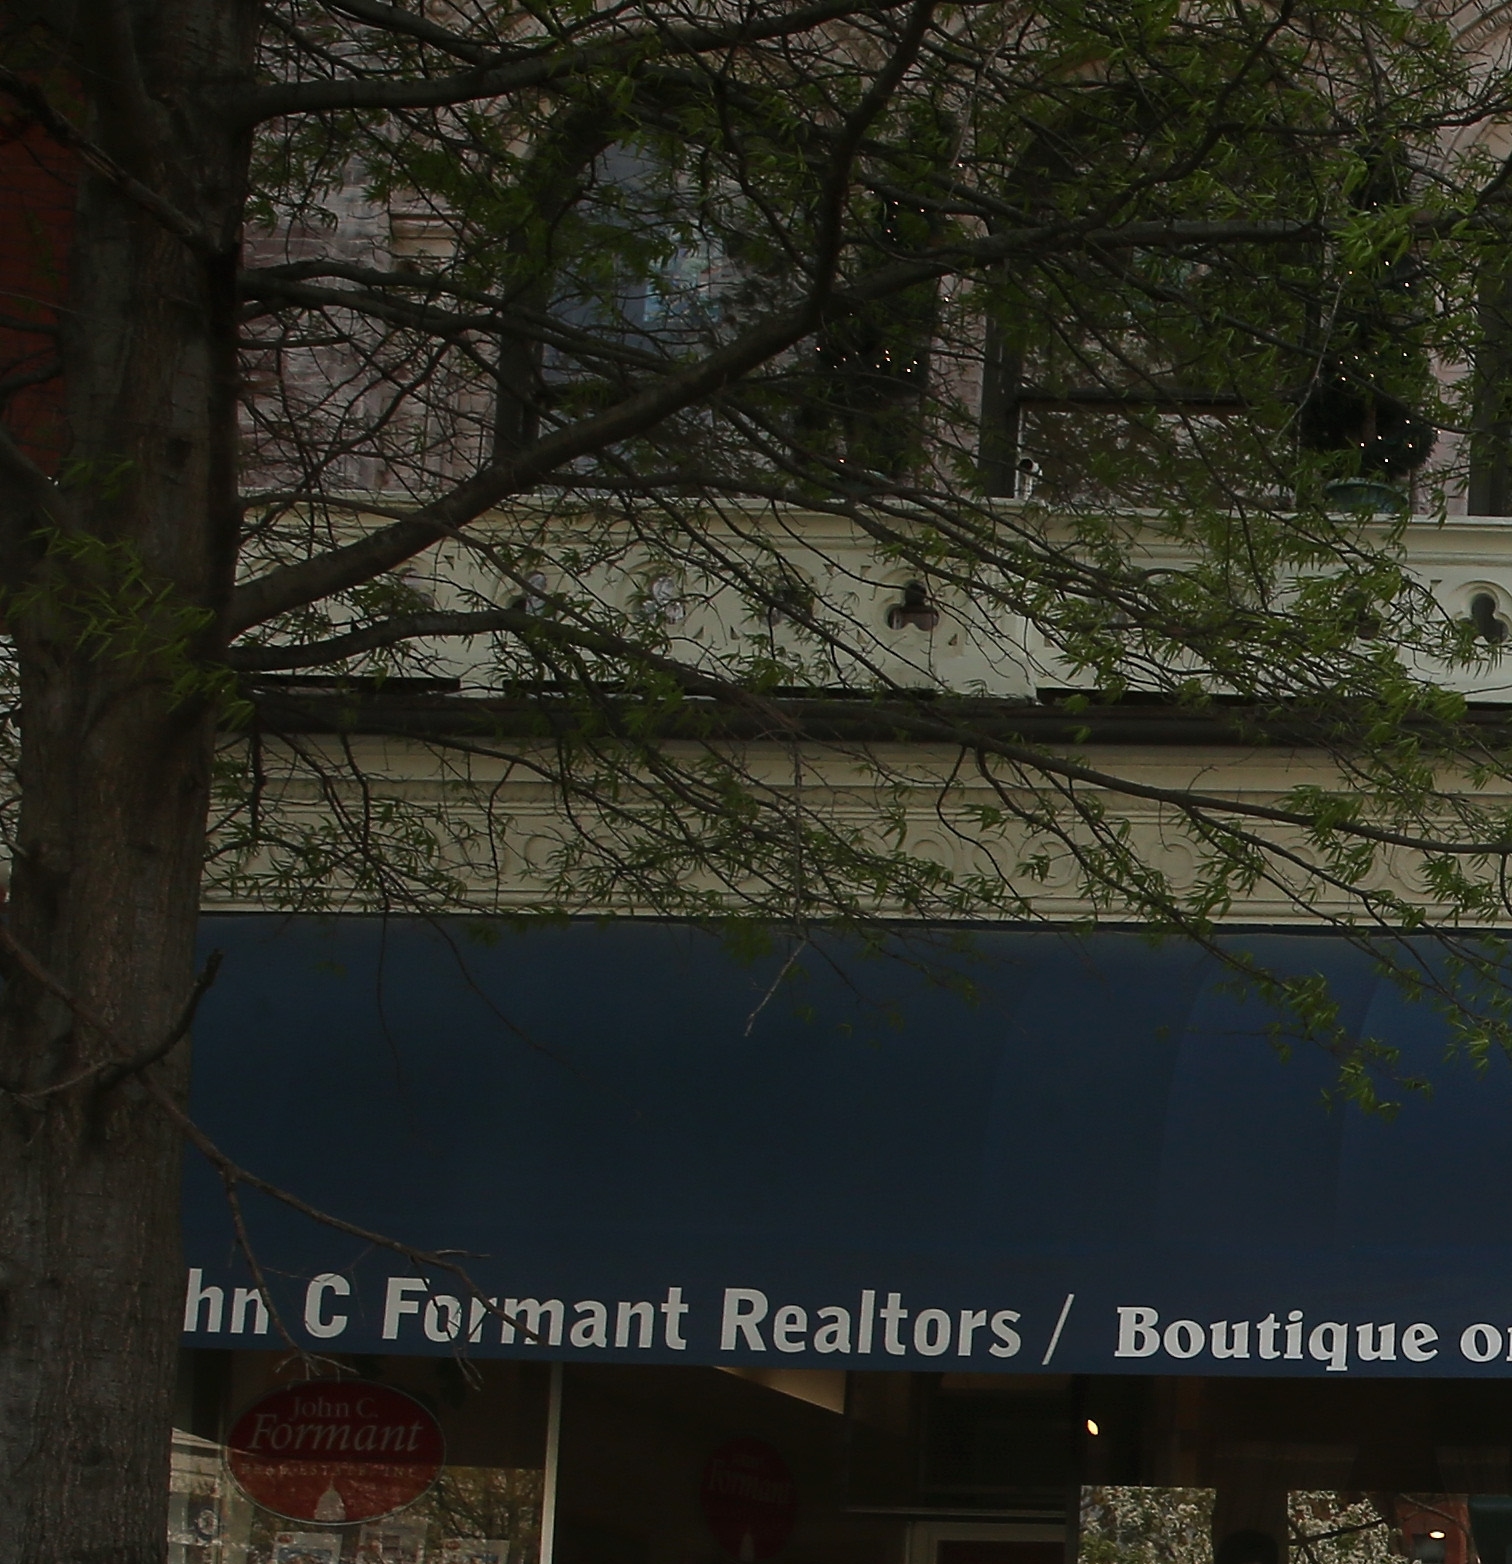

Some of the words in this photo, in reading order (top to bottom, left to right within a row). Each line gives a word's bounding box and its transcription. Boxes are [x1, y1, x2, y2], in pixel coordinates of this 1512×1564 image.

[304, 1273, 350, 1339] C
[382, 1277, 687, 1352] Formant
[719, 1287, 1023, 1359] Realtors
[1114, 1306, 1439, 1371] Boutique
[247, 1412, 424, 1452] Formant
[289, 1396, 350, 1420] John
